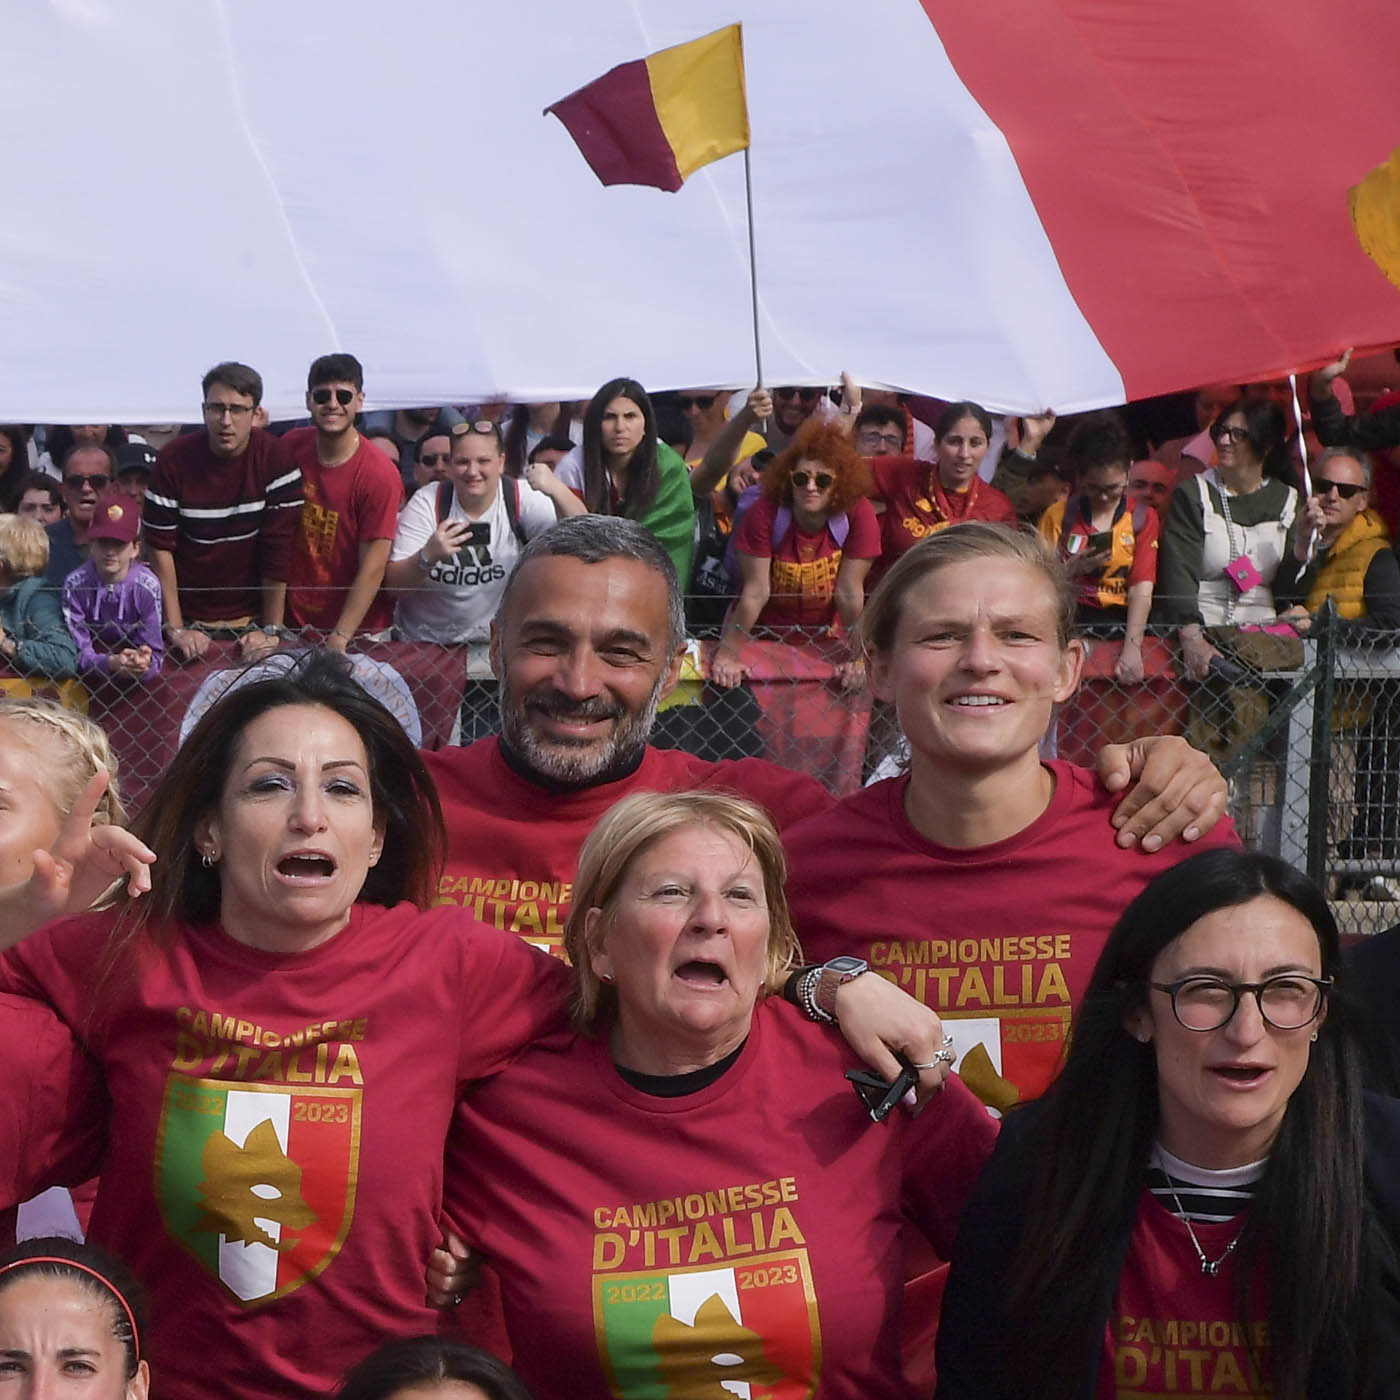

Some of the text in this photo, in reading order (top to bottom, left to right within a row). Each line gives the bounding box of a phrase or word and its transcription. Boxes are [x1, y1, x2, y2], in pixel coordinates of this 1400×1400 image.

[428, 564, 505, 585] adidas
[870, 934, 1071, 966] CAMPIONESSE
[175, 1006, 368, 1048] CAMPIONESSE
[1005, 1023, 1060, 1043] 2023
[294, 1102, 349, 1124] 2023
[593, 1176, 799, 1229] CAMPIONESSE
[592, 1206, 807, 1271] D'ITALIA
[606, 1264, 799, 1305] 2022 2023
